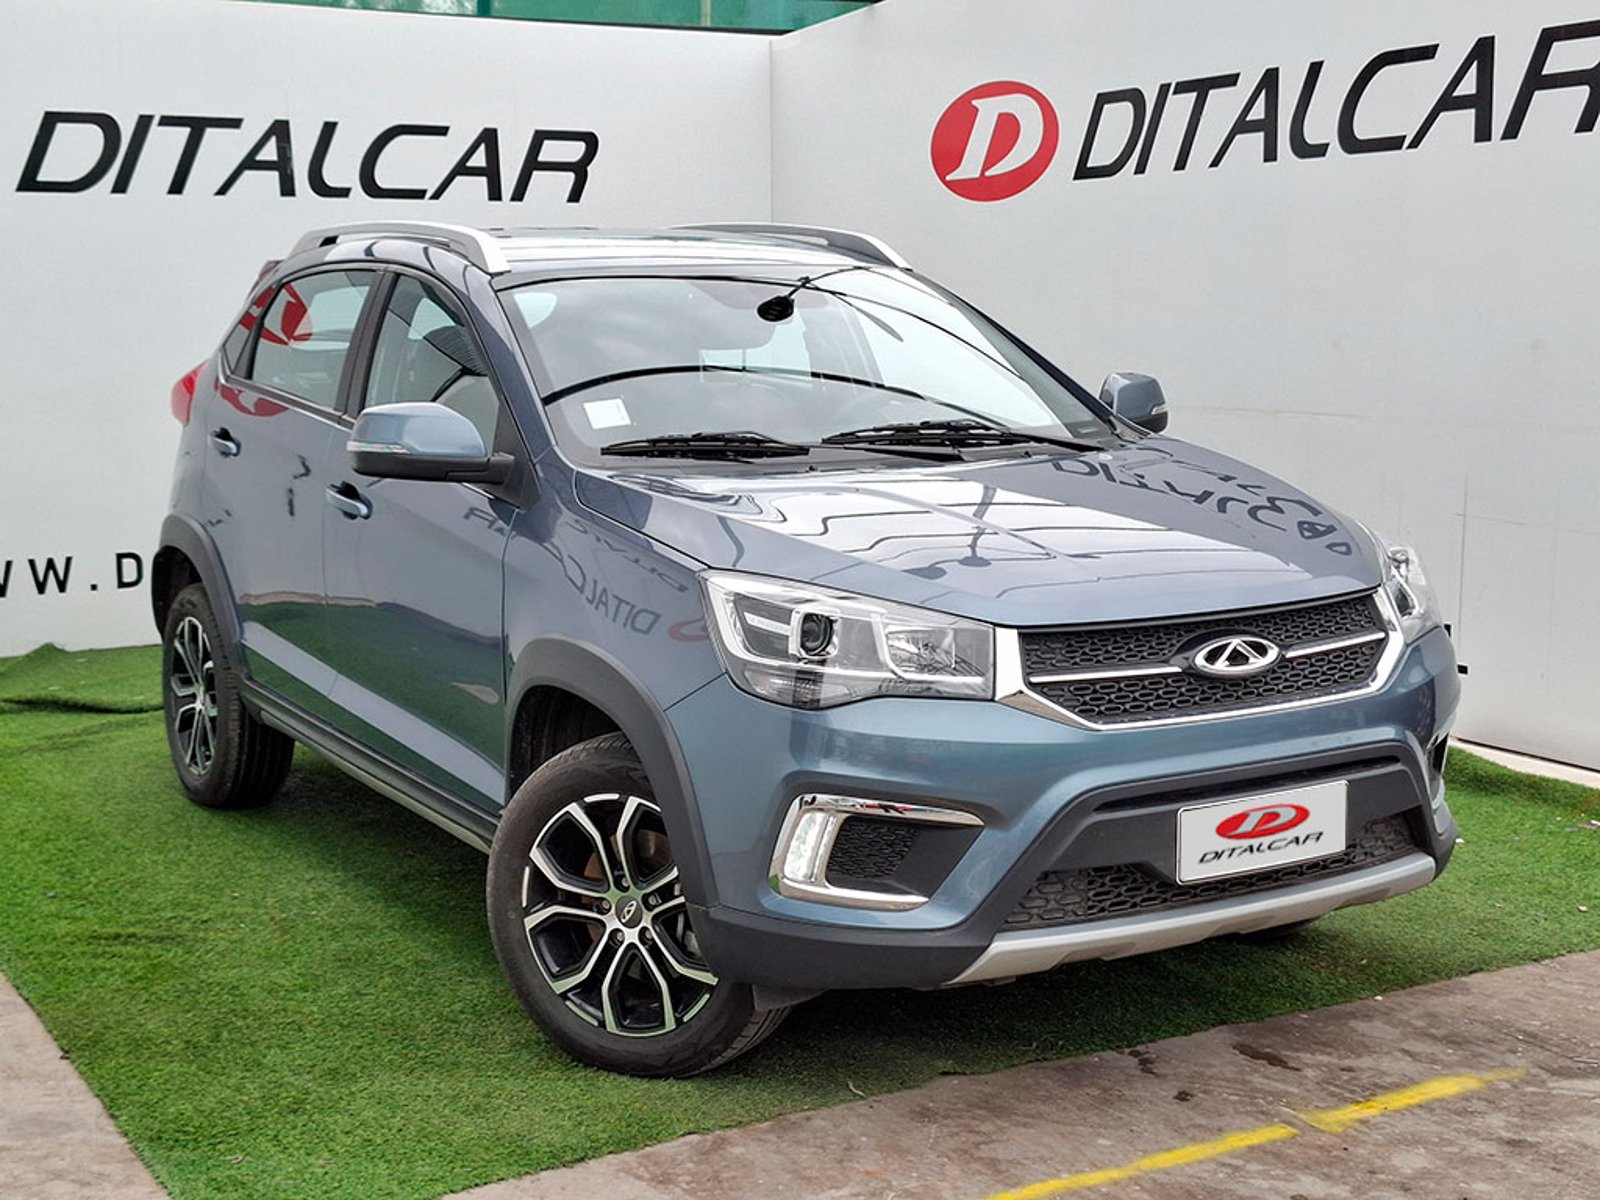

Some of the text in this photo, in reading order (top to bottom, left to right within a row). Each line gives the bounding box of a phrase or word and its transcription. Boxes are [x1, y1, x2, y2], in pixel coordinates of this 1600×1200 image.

[1072, 19, 1600, 181] DITALCAR
[15, 110, 599, 204] DITALCAR
[0, 552, 144, 598] W.D
[1199, 831, 1323, 864] DITALCAR
